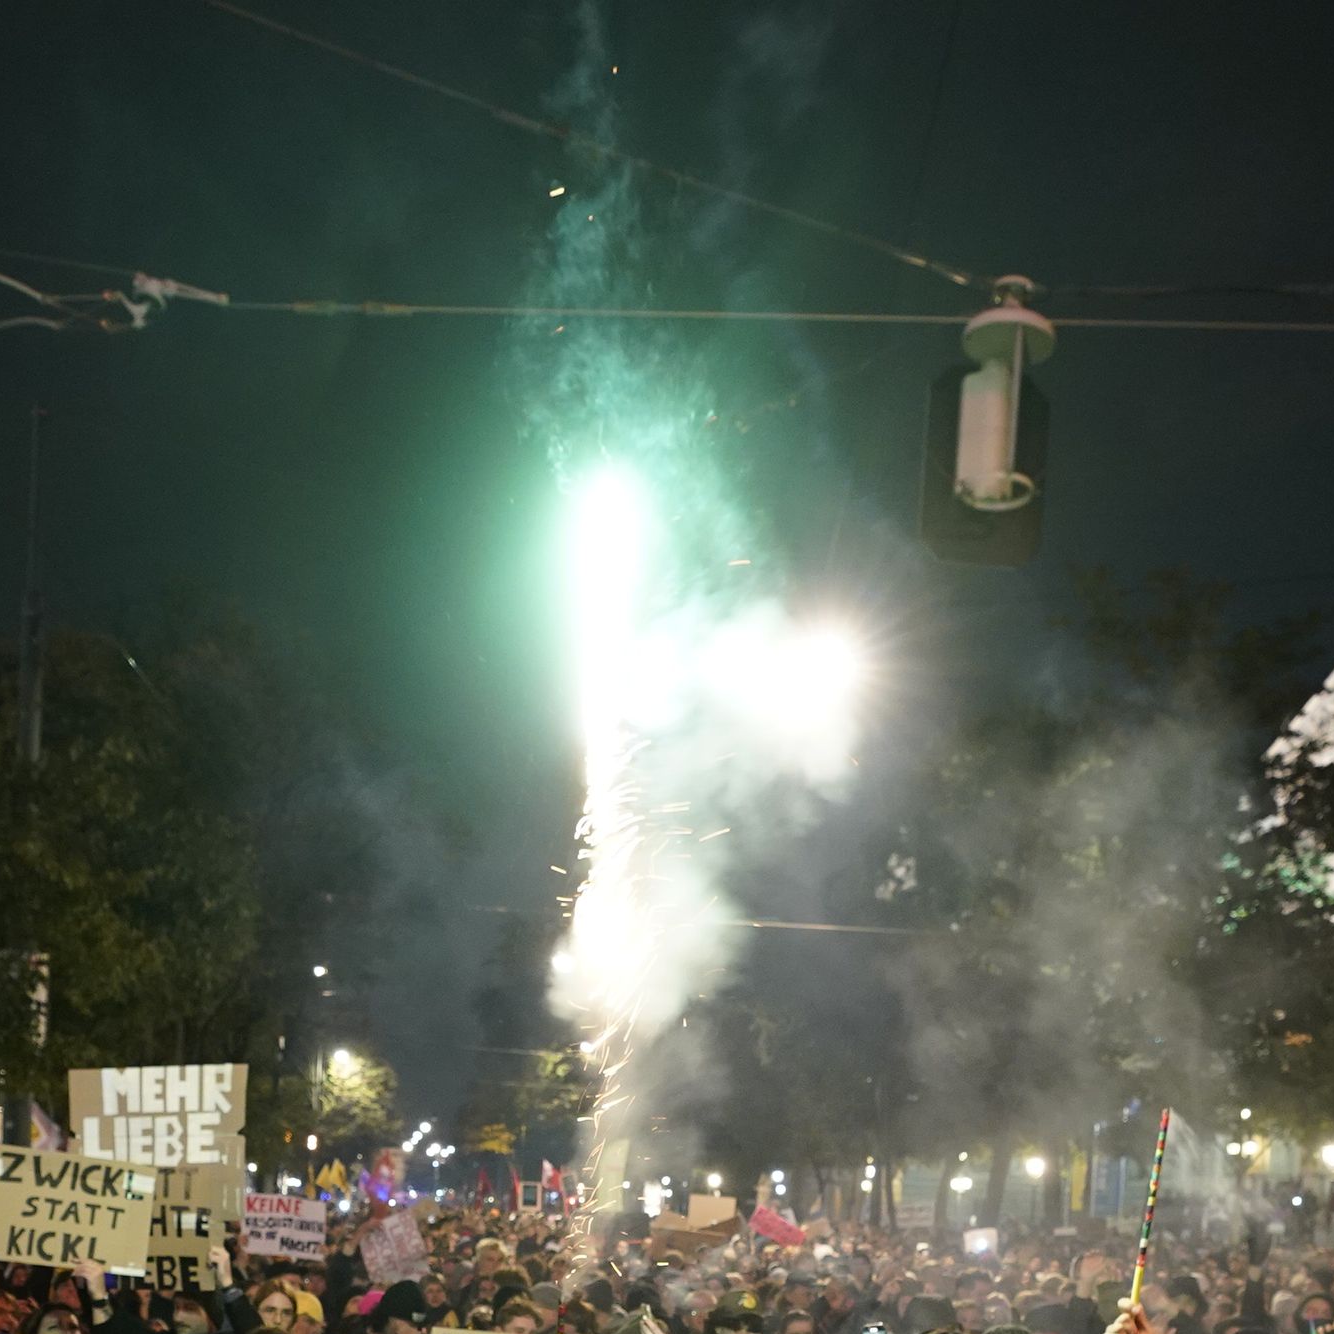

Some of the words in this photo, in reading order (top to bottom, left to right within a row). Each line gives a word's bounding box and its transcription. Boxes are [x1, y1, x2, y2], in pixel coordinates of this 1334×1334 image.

[101, 1062, 233, 1116] MEHR
[21, 1197, 125, 1229] STATT
[246, 1196, 303, 1216] KEINE
[6, 1226, 106, 1265] KICKL
